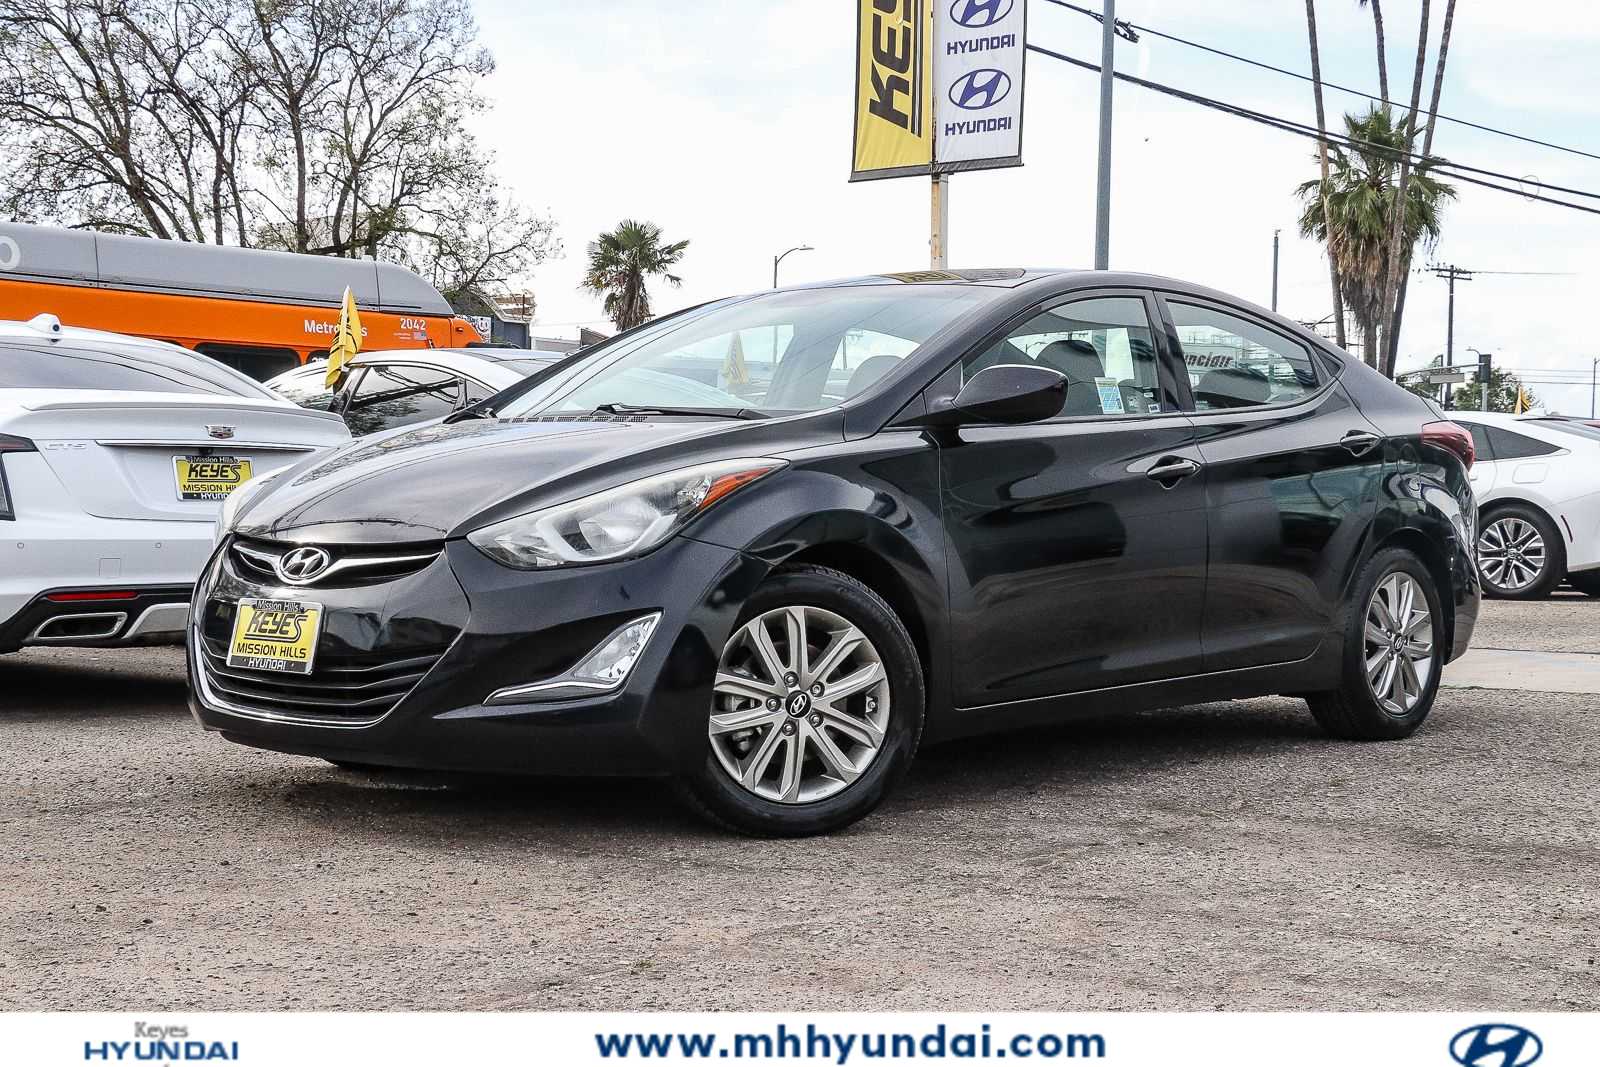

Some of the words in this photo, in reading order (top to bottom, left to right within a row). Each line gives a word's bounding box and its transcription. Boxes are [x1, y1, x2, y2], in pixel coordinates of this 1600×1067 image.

[947, 34, 1015, 55] HYUNDAI
[945, 117, 1012, 137] HYUNDAI
[400, 318, 426, 331] 2042
[187, 464, 241, 483] KEYES
[257, 600, 282, 611] Mission
[283, 602, 299, 612] Hills
[244, 611, 308, 643] KEYES
[237, 643, 277, 656] MISSION
[280, 647, 307, 658] HILLS
[248, 658, 286, 670] HYUNDAI
